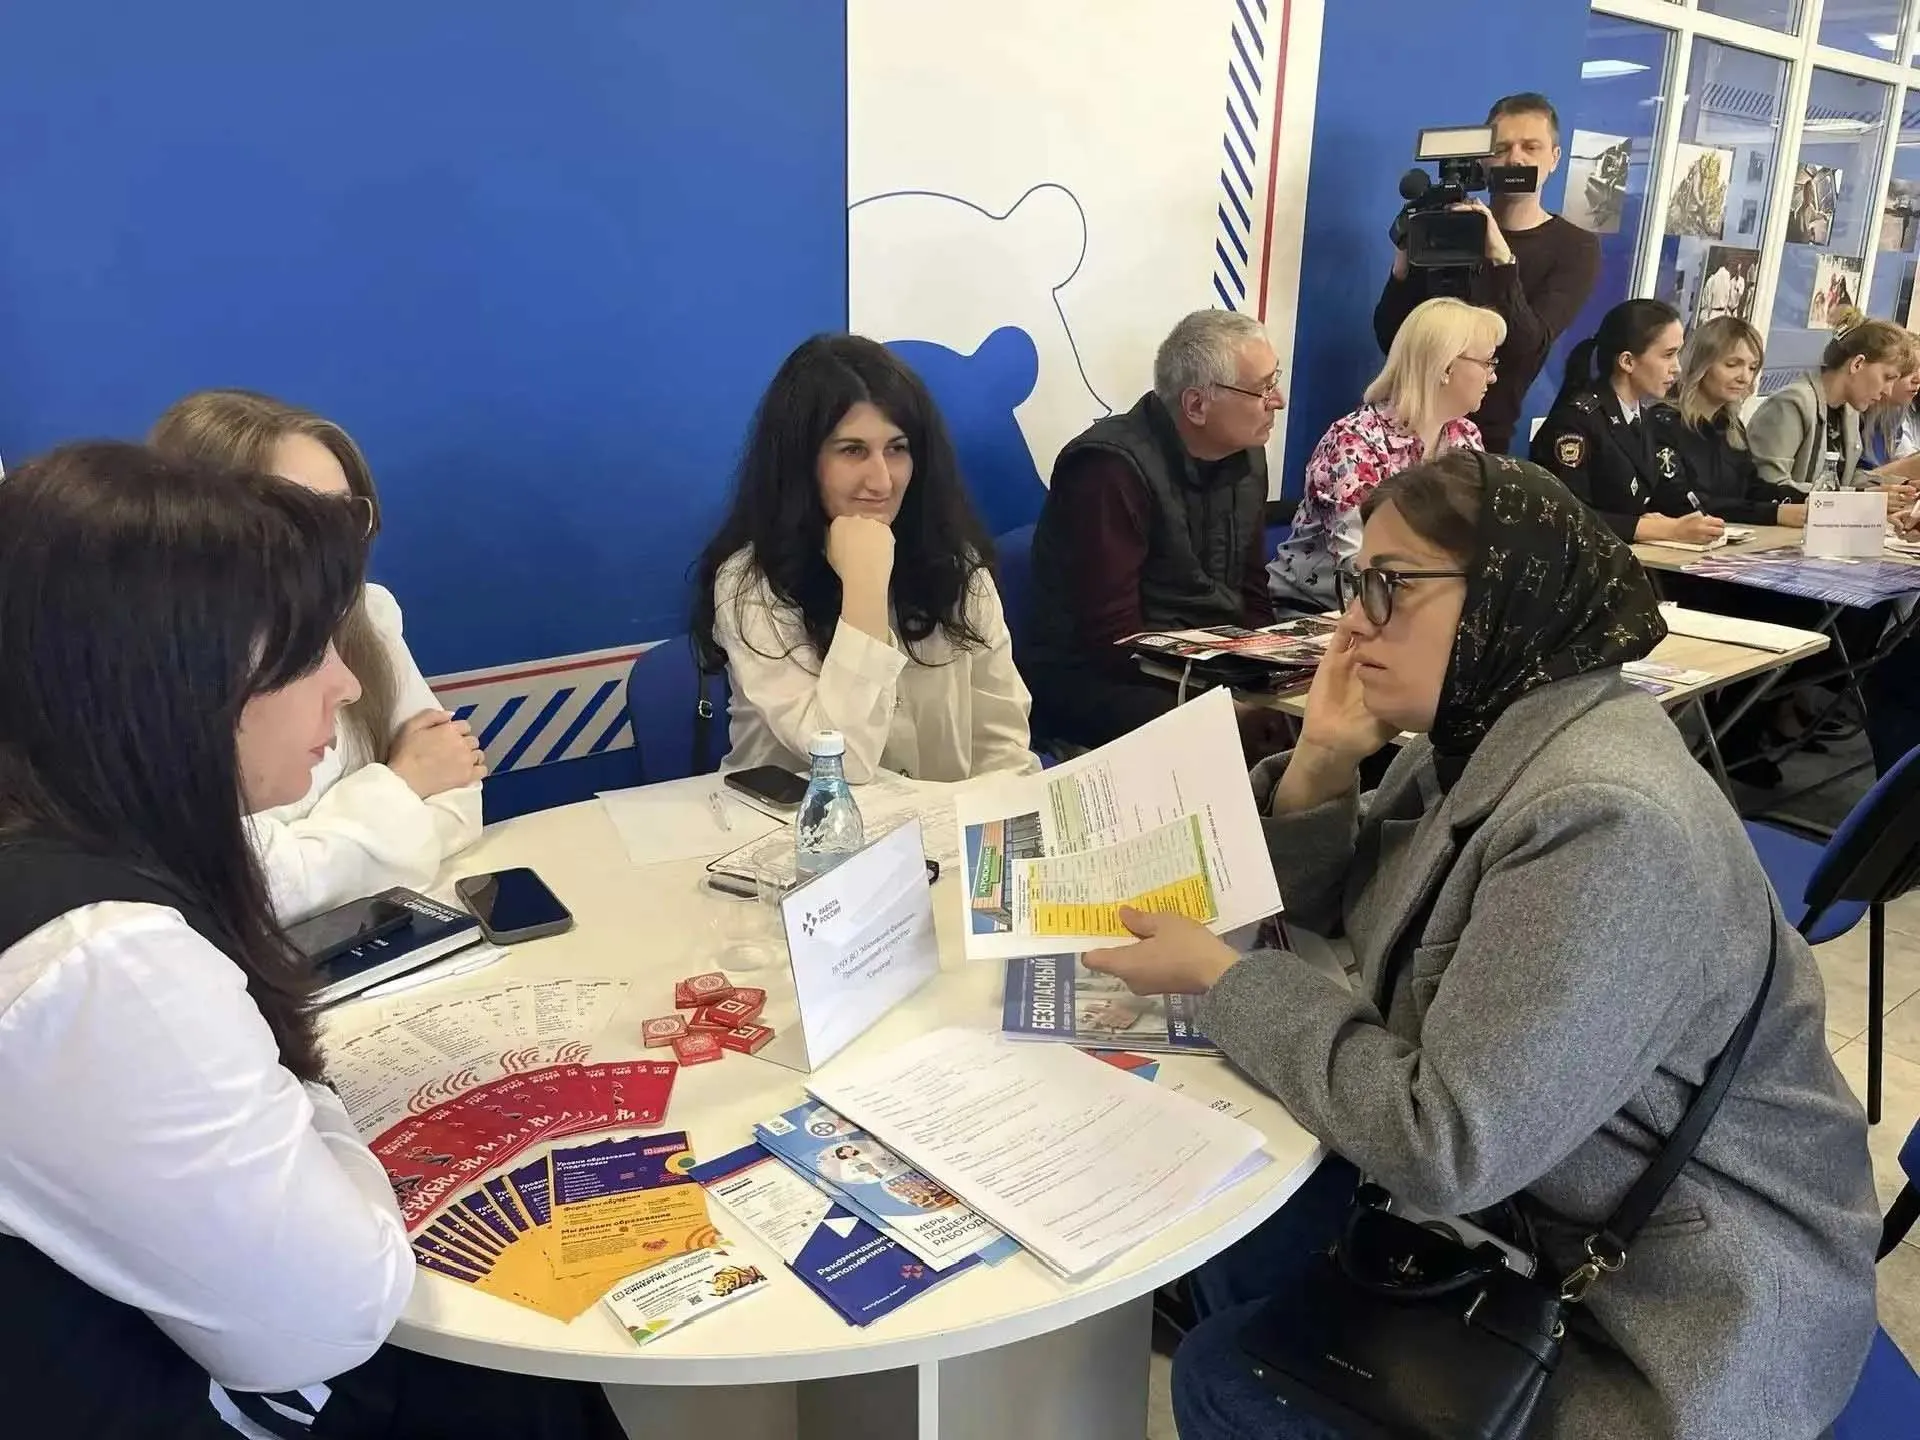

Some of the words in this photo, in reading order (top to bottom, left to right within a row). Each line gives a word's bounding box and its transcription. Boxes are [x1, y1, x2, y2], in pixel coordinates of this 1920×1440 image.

[818, 898, 839, 915] РАБОТА
[819, 905, 841, 923] РОССИИ
[1031, 957, 1056, 1031] БЕЗОПАСНЫЙ
[556, 1158, 585, 1168] Уровни
[587, 1152, 637, 1163] образования
[564, 1201, 602, 1212] Форматы
[603, 1194, 640, 1205] обучения
[578, 1223, 612, 1234] делаем
[914, 1215, 949, 1233] МЕРЫ
[922, 1211, 979, 1241] ПОДДЕРЖ
[932, 1217, 988, 1247] РАБОТОД
[825, 1245, 886, 1282] заполнению
[624, 1273, 667, 1295] СИНЕРГИЯ
